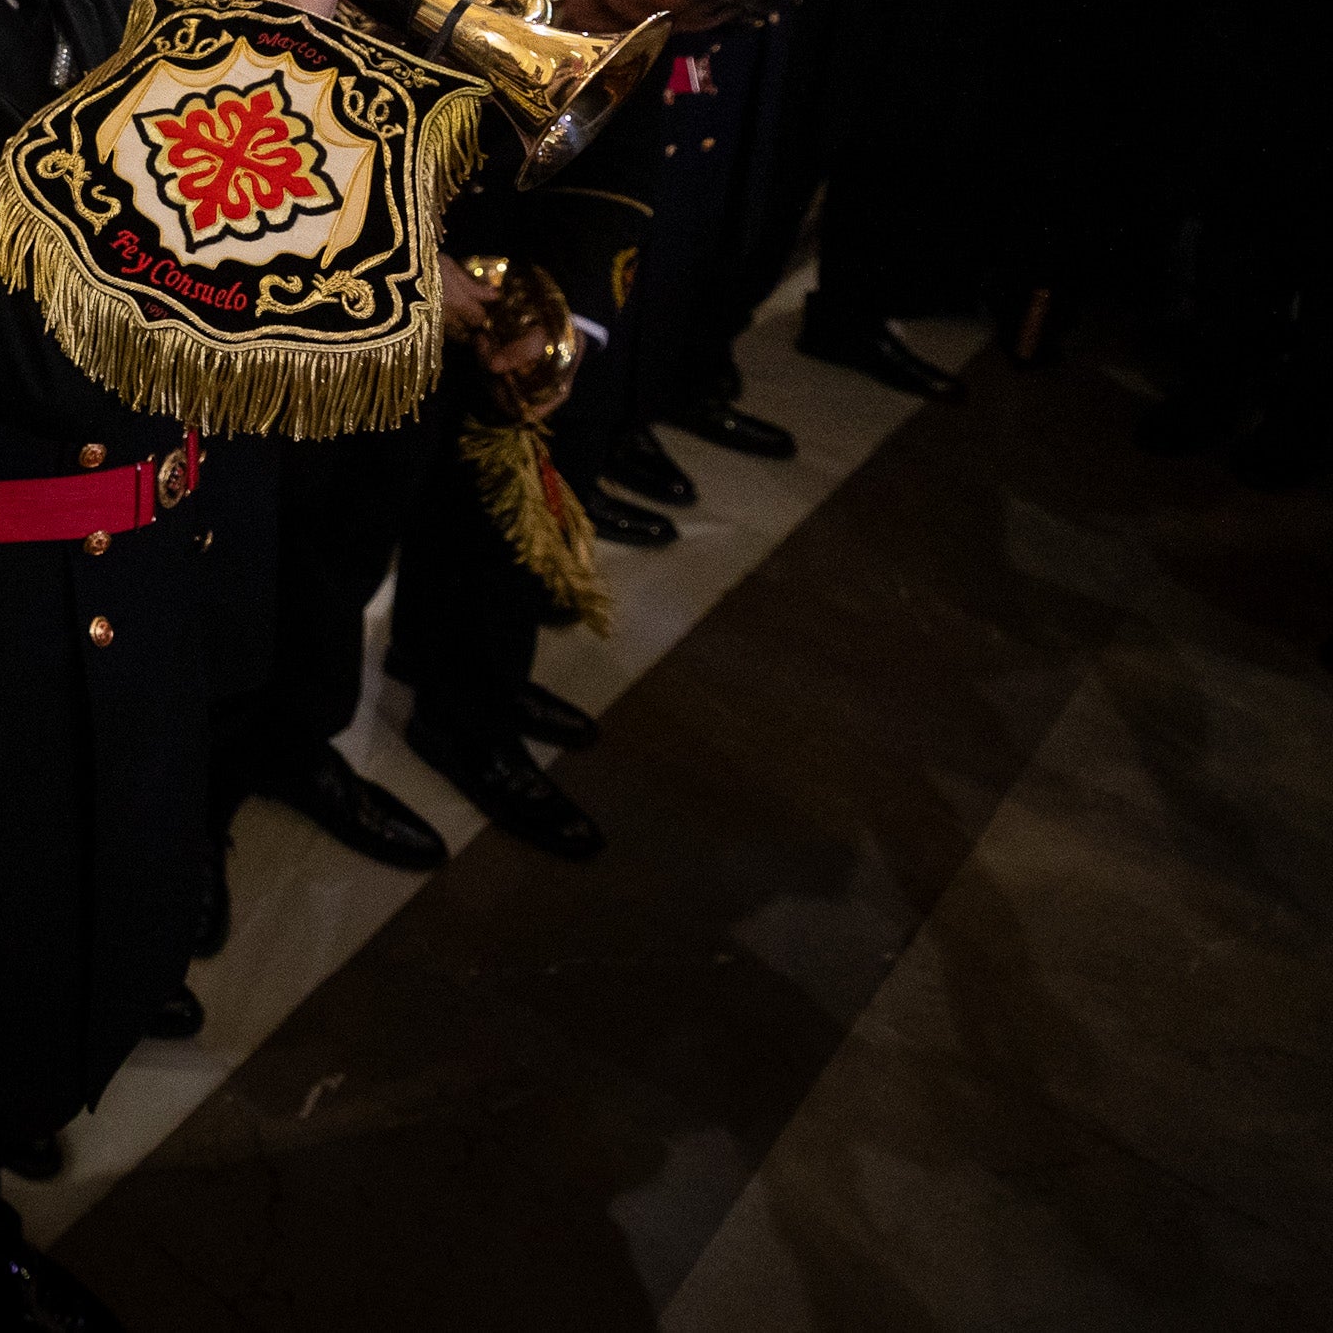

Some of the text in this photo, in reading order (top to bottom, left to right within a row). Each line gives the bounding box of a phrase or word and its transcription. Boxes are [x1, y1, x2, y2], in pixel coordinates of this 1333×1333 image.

[257, 32, 328, 64] Martos
[109, 229, 248, 312] Fe y Consuelo
